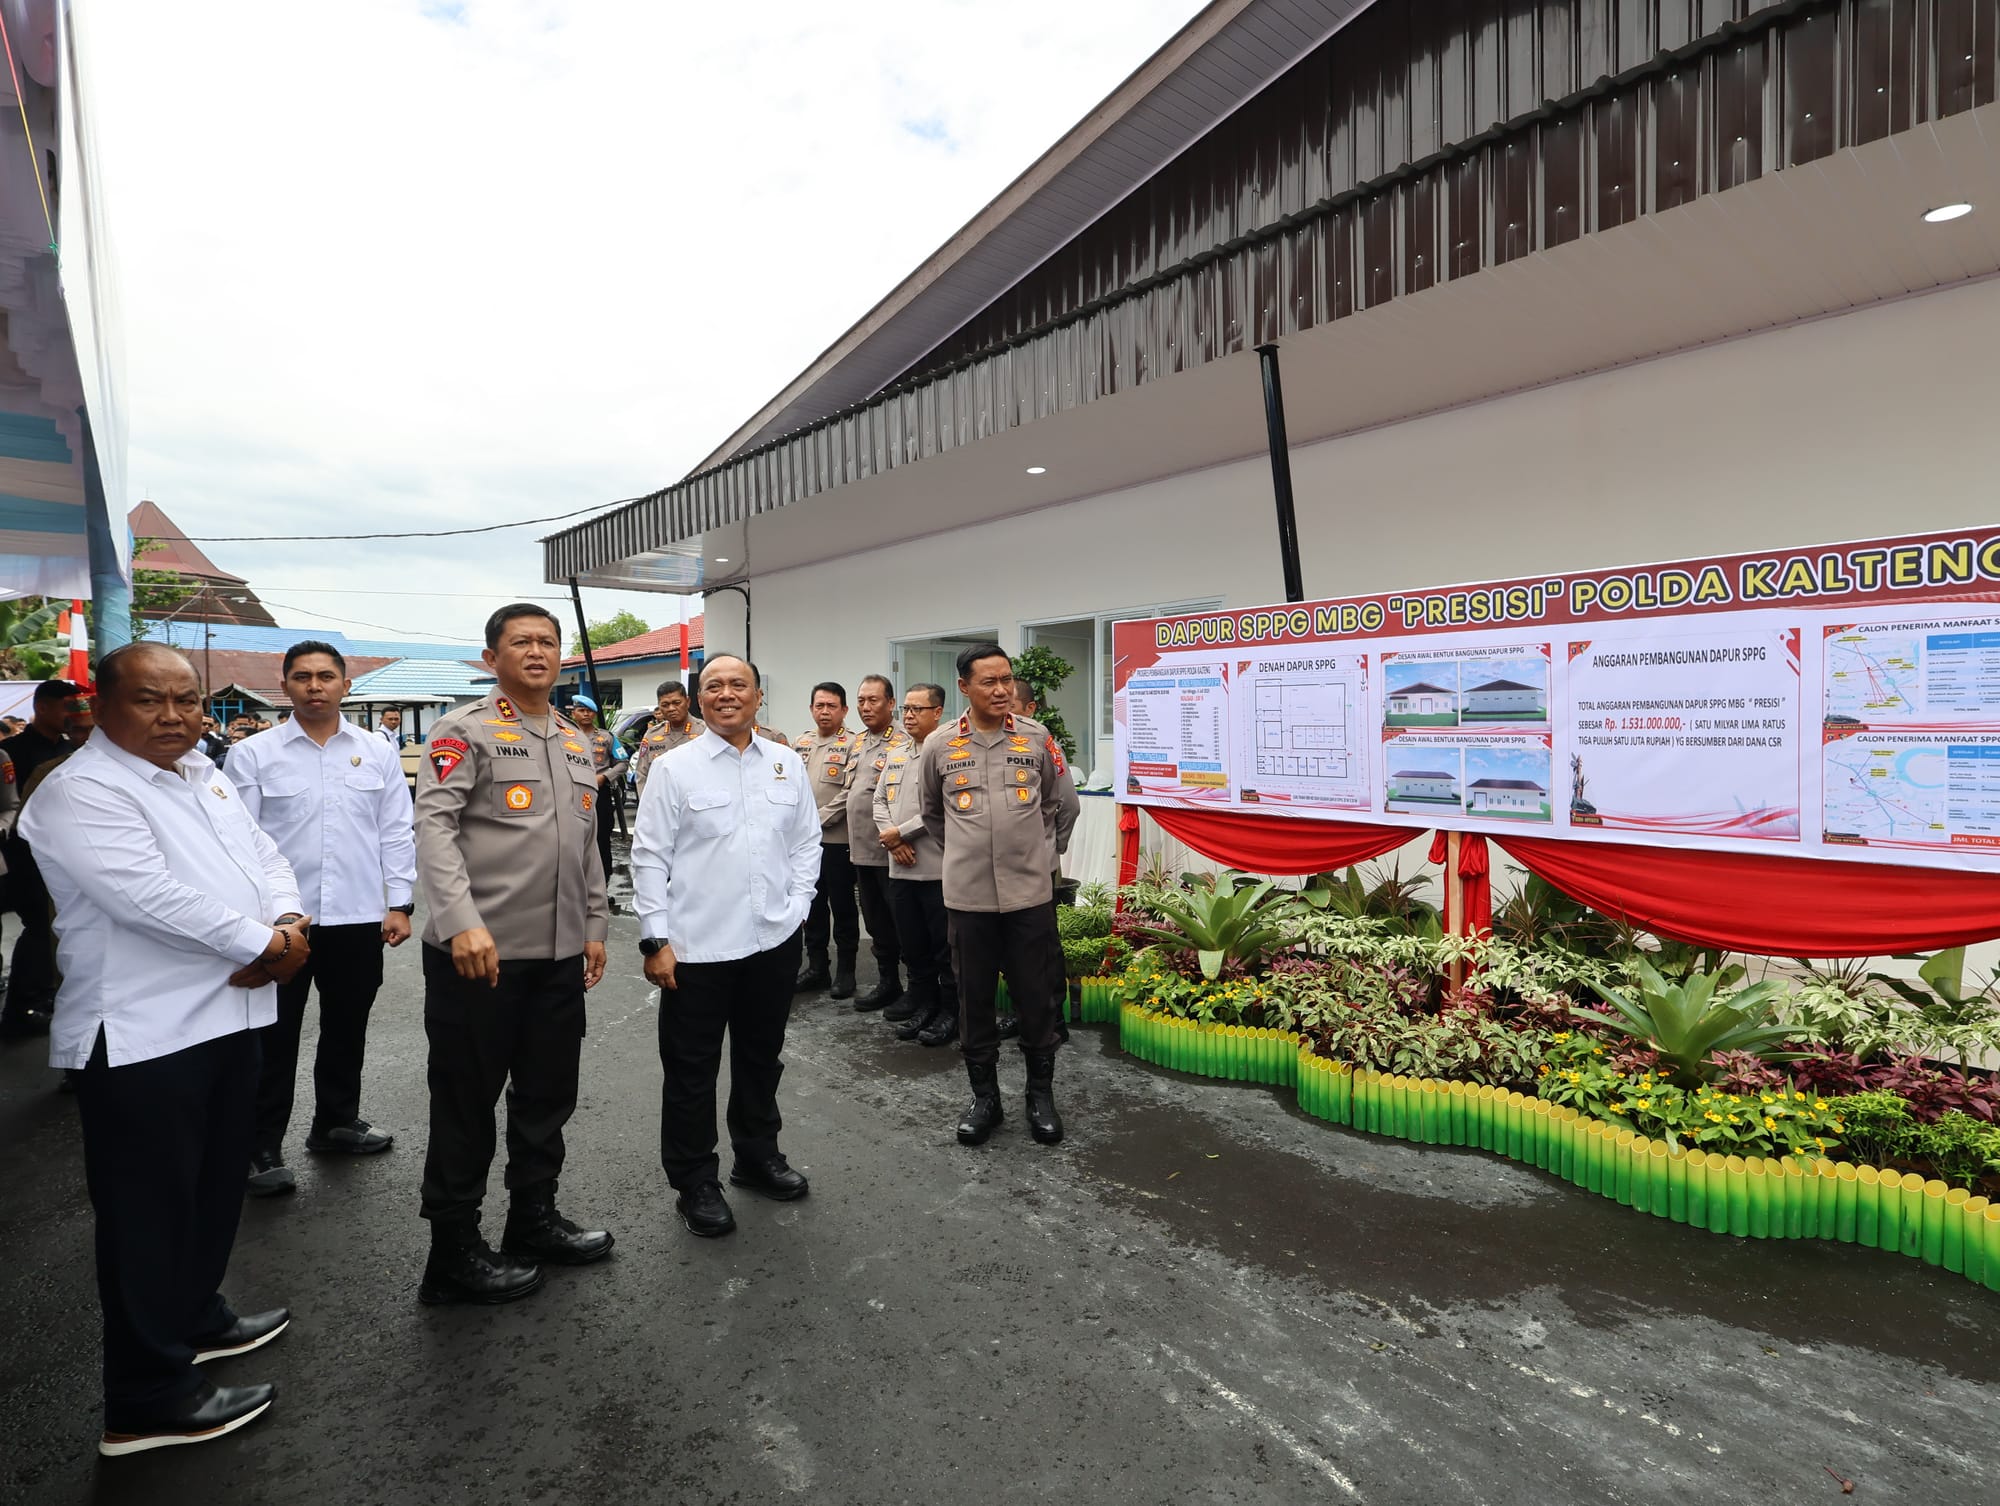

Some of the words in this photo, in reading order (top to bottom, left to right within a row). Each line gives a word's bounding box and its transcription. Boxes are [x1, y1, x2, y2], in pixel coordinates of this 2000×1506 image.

[1157, 618, 1234, 645] DAPUR
[1241, 611, 1309, 639] SPPG
[1316, 603, 1383, 633] MBG
[1391, 582, 1561, 626] "PRESISI"
[1573, 568, 1729, 613] POLDA
[1858, 625, 1889, 633] CALON
[1891, 621, 1942, 631] PENERIMA
[1943, 618, 1991, 629] MANFAAT
[1455, 649, 1488, 657] BANGUNAN
[1509, 646, 1525, 654] SPPG
[1593, 653, 1638, 668] ANGGARAN
[1639, 650, 1708, 666] PEMBANGUNAN
[1710, 648, 1741, 664] DAPUR
[1743, 646, 1766, 661] SPPG
[1259, 662, 1285, 673] DENAH
[1287, 660, 1314, 672] DAPUR
[1315, 658, 1336, 671] SPPG
[1578, 701, 1596, 711] TOTAL
[1596, 700, 1631, 711] ANGGARAN
[1632, 699, 1684, 710] PEMBANGUNAN
[1685, 699, 1708, 709] DAPUR
[1709, 698, 1727, 709] SPPG
[1728, 698, 1745, 708] MBG
[1754, 697, 1781, 708] PRESISI
[1578, 720, 1603, 730] SEBESAR
[1604, 718, 1617, 732] Rp.
[1621, 717, 1685, 731] 1.531.000.000,-
[1695, 719, 1712, 729] SATU
[1714, 719, 1739, 729] MILYAR
[1741, 719, 1759, 729] LIMA
[1762, 719, 1786, 729] RATUS
[1490, 736, 1510, 744] DAPUR
[1578, 736, 1592, 745] TIGA
[1592, 736, 1613, 746] PULUH
[1614, 736, 1630, 746] SATU
[1630, 736, 1645, 746] JUTA
[1646, 736, 1671, 746] RUPIAH
[1676, 736, 1684, 746] YG
[1685, 737, 1727, 747] BERSUMBER
[1728, 737, 1745, 747] DARI
[1746, 737, 1767, 747] DANA
[1768, 737, 1782, 747] CSR
[1857, 735, 1885, 743] CALON
[1887, 735, 1932, 743] PENERIMA
[496, 745, 530, 758] IWAN
[566, 753, 592, 767] POLRI
[946, 760, 976, 771] RAKHMAD
[1007, 756, 1034, 766] POLRI
